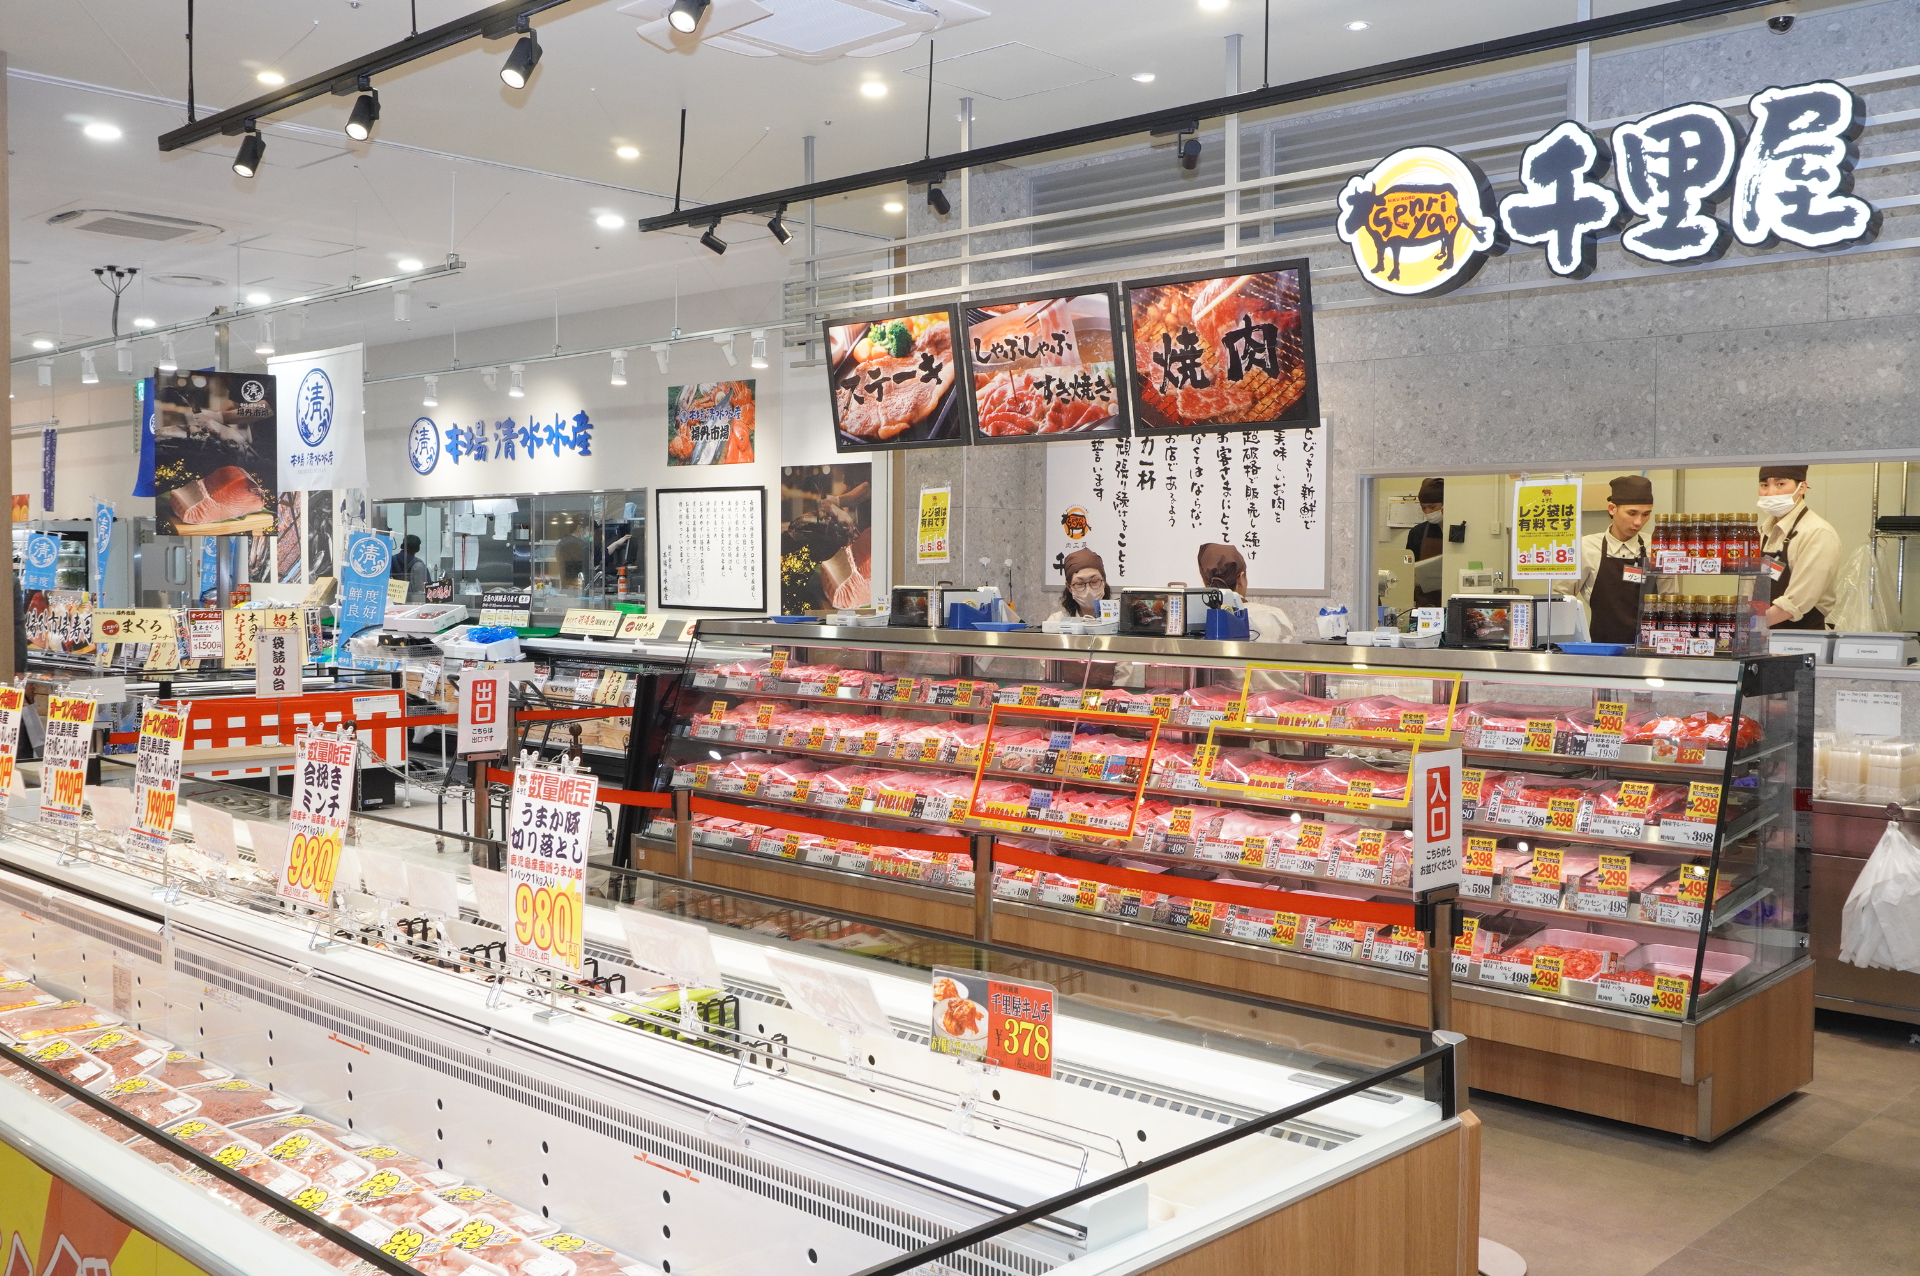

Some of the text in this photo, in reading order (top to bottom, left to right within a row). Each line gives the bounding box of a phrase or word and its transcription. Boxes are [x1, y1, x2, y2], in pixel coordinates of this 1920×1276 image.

[1507, 90, 1857, 267] 千里屋
[973, 330, 1073, 365] しゃぶしゃぶ
[1153, 316, 1278, 393] 焼肉
[841, 354, 944, 410] ステーキ
[1033, 372, 1112, 406] すき焼き
[445, 410, 595, 464] 本場 清水水産
[691, 424, 731, 441] 場外市場
[1136, 437, 1156, 490] 力一杯
[922, 507, 947, 518] レジ袋は
[1520, 504, 1574, 518] レジ袋は
[921, 517, 947, 528] 有料です
[1519, 518, 1574, 531] 有料です
[349, 587, 379, 604] 鮮度
[347, 603, 377, 620] 良好
[122, 619, 161, 633] まぐろ
[272, 636, 286, 691] 袋詰め台
[476, 682, 493, 721] 出口
[1155, 706, 1169, 720] 980
[48, 721, 80, 738] 鹿児島県産
[1600, 715, 1622, 731] 990
[140, 736, 171, 756] 鹿児島県産
[472, 735, 494, 743] 出口です
[1530, 733, 1551, 749] 798
[307, 741, 351, 766] 数量限定
[304, 761, 342, 791] 合挽き
[1088, 763, 1103, 777] 698
[54, 769, 84, 807] 1990円
[528, 773, 592, 807] 数量限定
[144, 789, 176, 832] 1990円
[302, 789, 340, 818] ミンチ
[1430, 772, 1447, 837] 入口
[1624, 795, 1647, 810] 348
[1693, 797, 1718, 814] 298
[522, 802, 581, 835] うまか豚
[952, 808, 966, 821] 299
[1552, 812, 1574, 828] 398
[1173, 820, 1190, 833] 299
[511, 827, 583, 864] 切り落とし
[1302, 835, 1320, 850] 268
[1361, 842, 1380, 857] 198
[1245, 848, 1263, 863] 298
[1426, 846, 1451, 859] こちらから
[1472, 851, 1493, 867] 398
[1420, 859, 1457, 875] お並びください
[1538, 862, 1560, 880] 298
[1605, 869, 1627, 887] 299
[1080, 891, 1095, 906] 198
[1193, 911, 1211, 927] 248
[1277, 925, 1295, 941] 248
[515, 943, 549, 963] 税込1058.4円
[1537, 970, 1559, 988] 298
[991, 994, 1050, 1021] 千里屋キムチ
[1658, 992, 1683, 1011] 398
